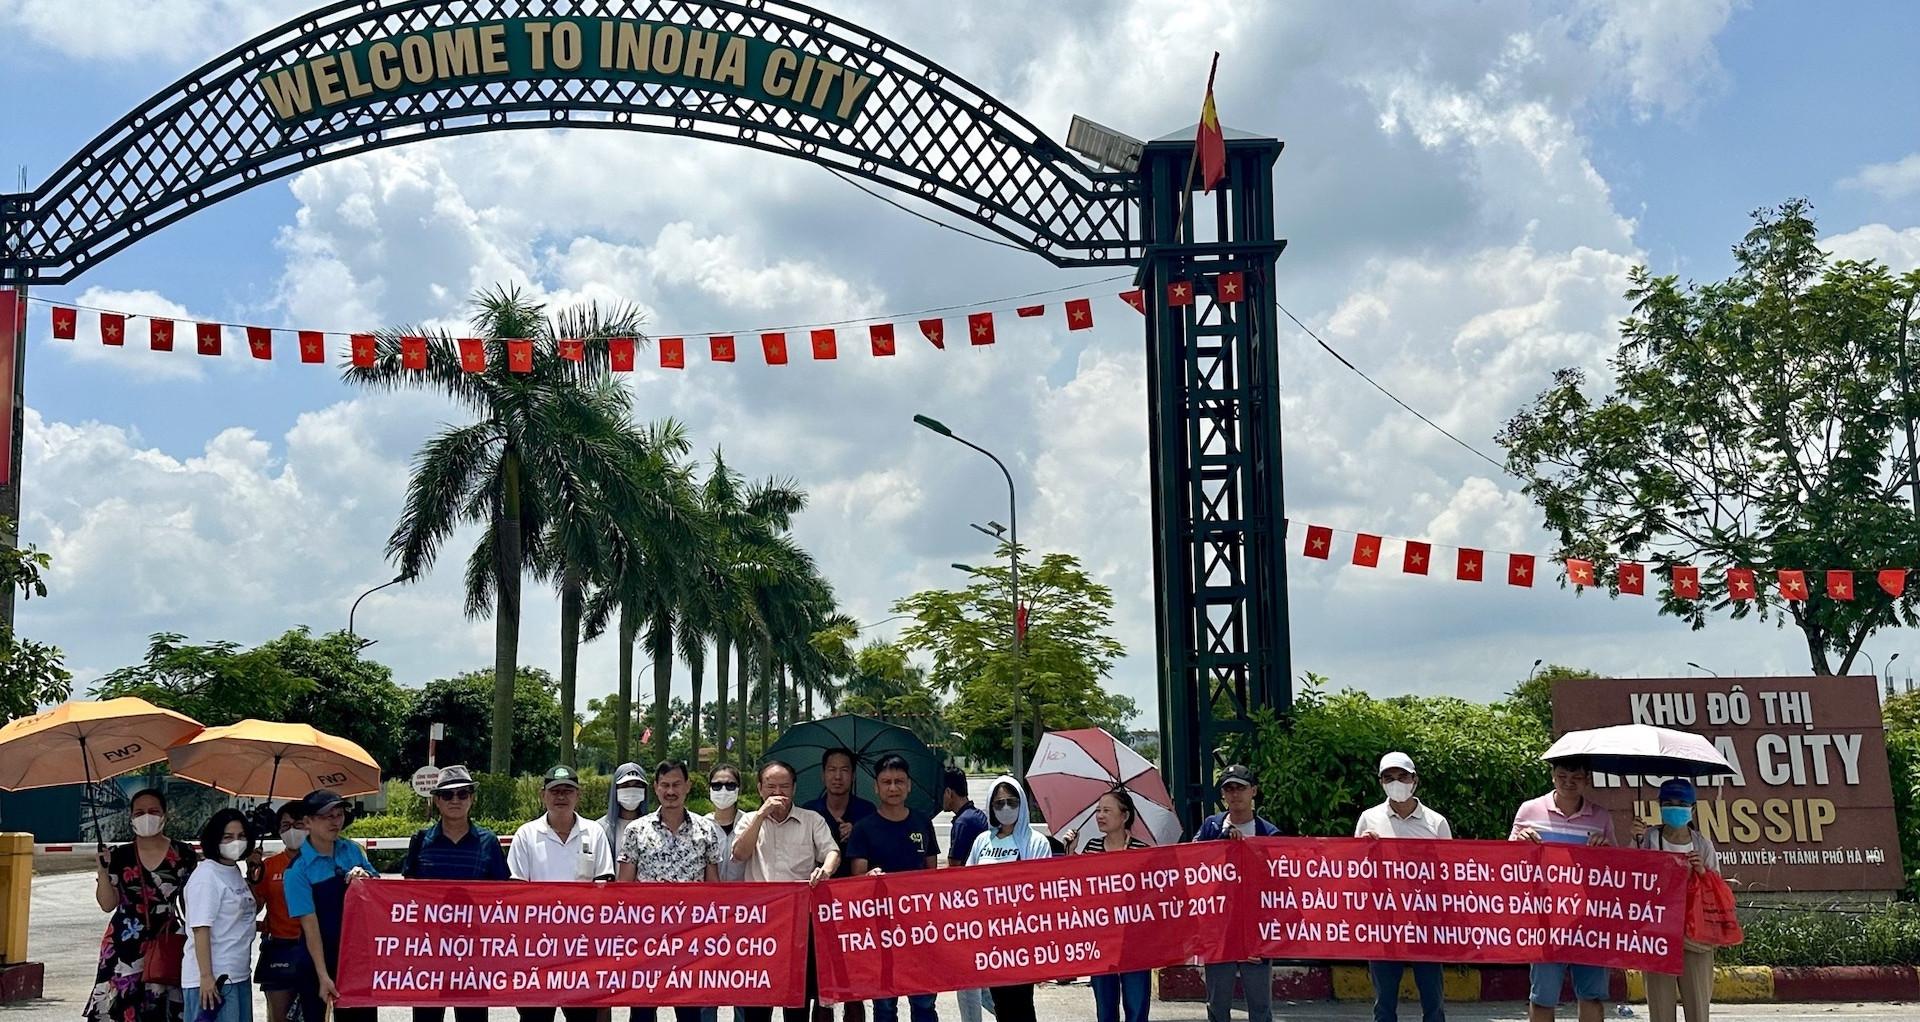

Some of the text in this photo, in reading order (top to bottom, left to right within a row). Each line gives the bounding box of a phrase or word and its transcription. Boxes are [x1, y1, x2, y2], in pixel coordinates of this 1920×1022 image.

[260, 20, 871, 120] WELCOME TO INOHA CITY
[1630, 685, 1814, 730] KHU ĐÔ THỊ
[103, 743, 142, 761] FWD
[1756, 733, 1863, 786] CITY
[317, 772, 347, 786] FWD
[1633, 798, 1836, 843] HNSSIP
[980, 847, 1019, 858] Chillers
[1822, 846, 1844, 864] PHỐ
[1847, 846, 1863, 864] HÀ
[1866, 846, 1885, 866] NỘI
[818, 862, 1241, 922] ĐỀ NGHỊ CTY N&G THỰC HIỆN THEO HỢP ĐỒNG,
[1267, 855, 1660, 894] YÊU CẦU ĐỐI THOẠI 3 BÊN: GIỮA CHỦ ĐẦU TƯ,
[391, 900, 766, 927] ĐỀ NGHỊ VĂN PHÒNG ĐĂNG KÝ ĐẤT ĐAI
[1261, 887, 1665, 923] NHÀ ĐẦU TƯ VÀ VĂN PHÒNG ĐĂNG KÝ NHÀ ĐẤT
[838, 896, 1225, 952] TRẢ SỔ ĐỎ CHO KHÁCH HÀNG MUA TỪ 2017
[1259, 919, 1667, 955] VỀ VẤN ĐỀ CHUYỂN NHƯỢNG CHO KHÁCH HÀNG
[375, 933, 776, 961] TP HÀ NỘI TRẢ LỜI VỀ VIỆC CẤP 4 SỔ CHO
[975, 941, 1100, 970] ĐÓNG ĐỦ 95%
[373, 966, 771, 993] KHÁCH HÀNG ĐÃ MUA TẠI DỰ ÁN INNOHA
